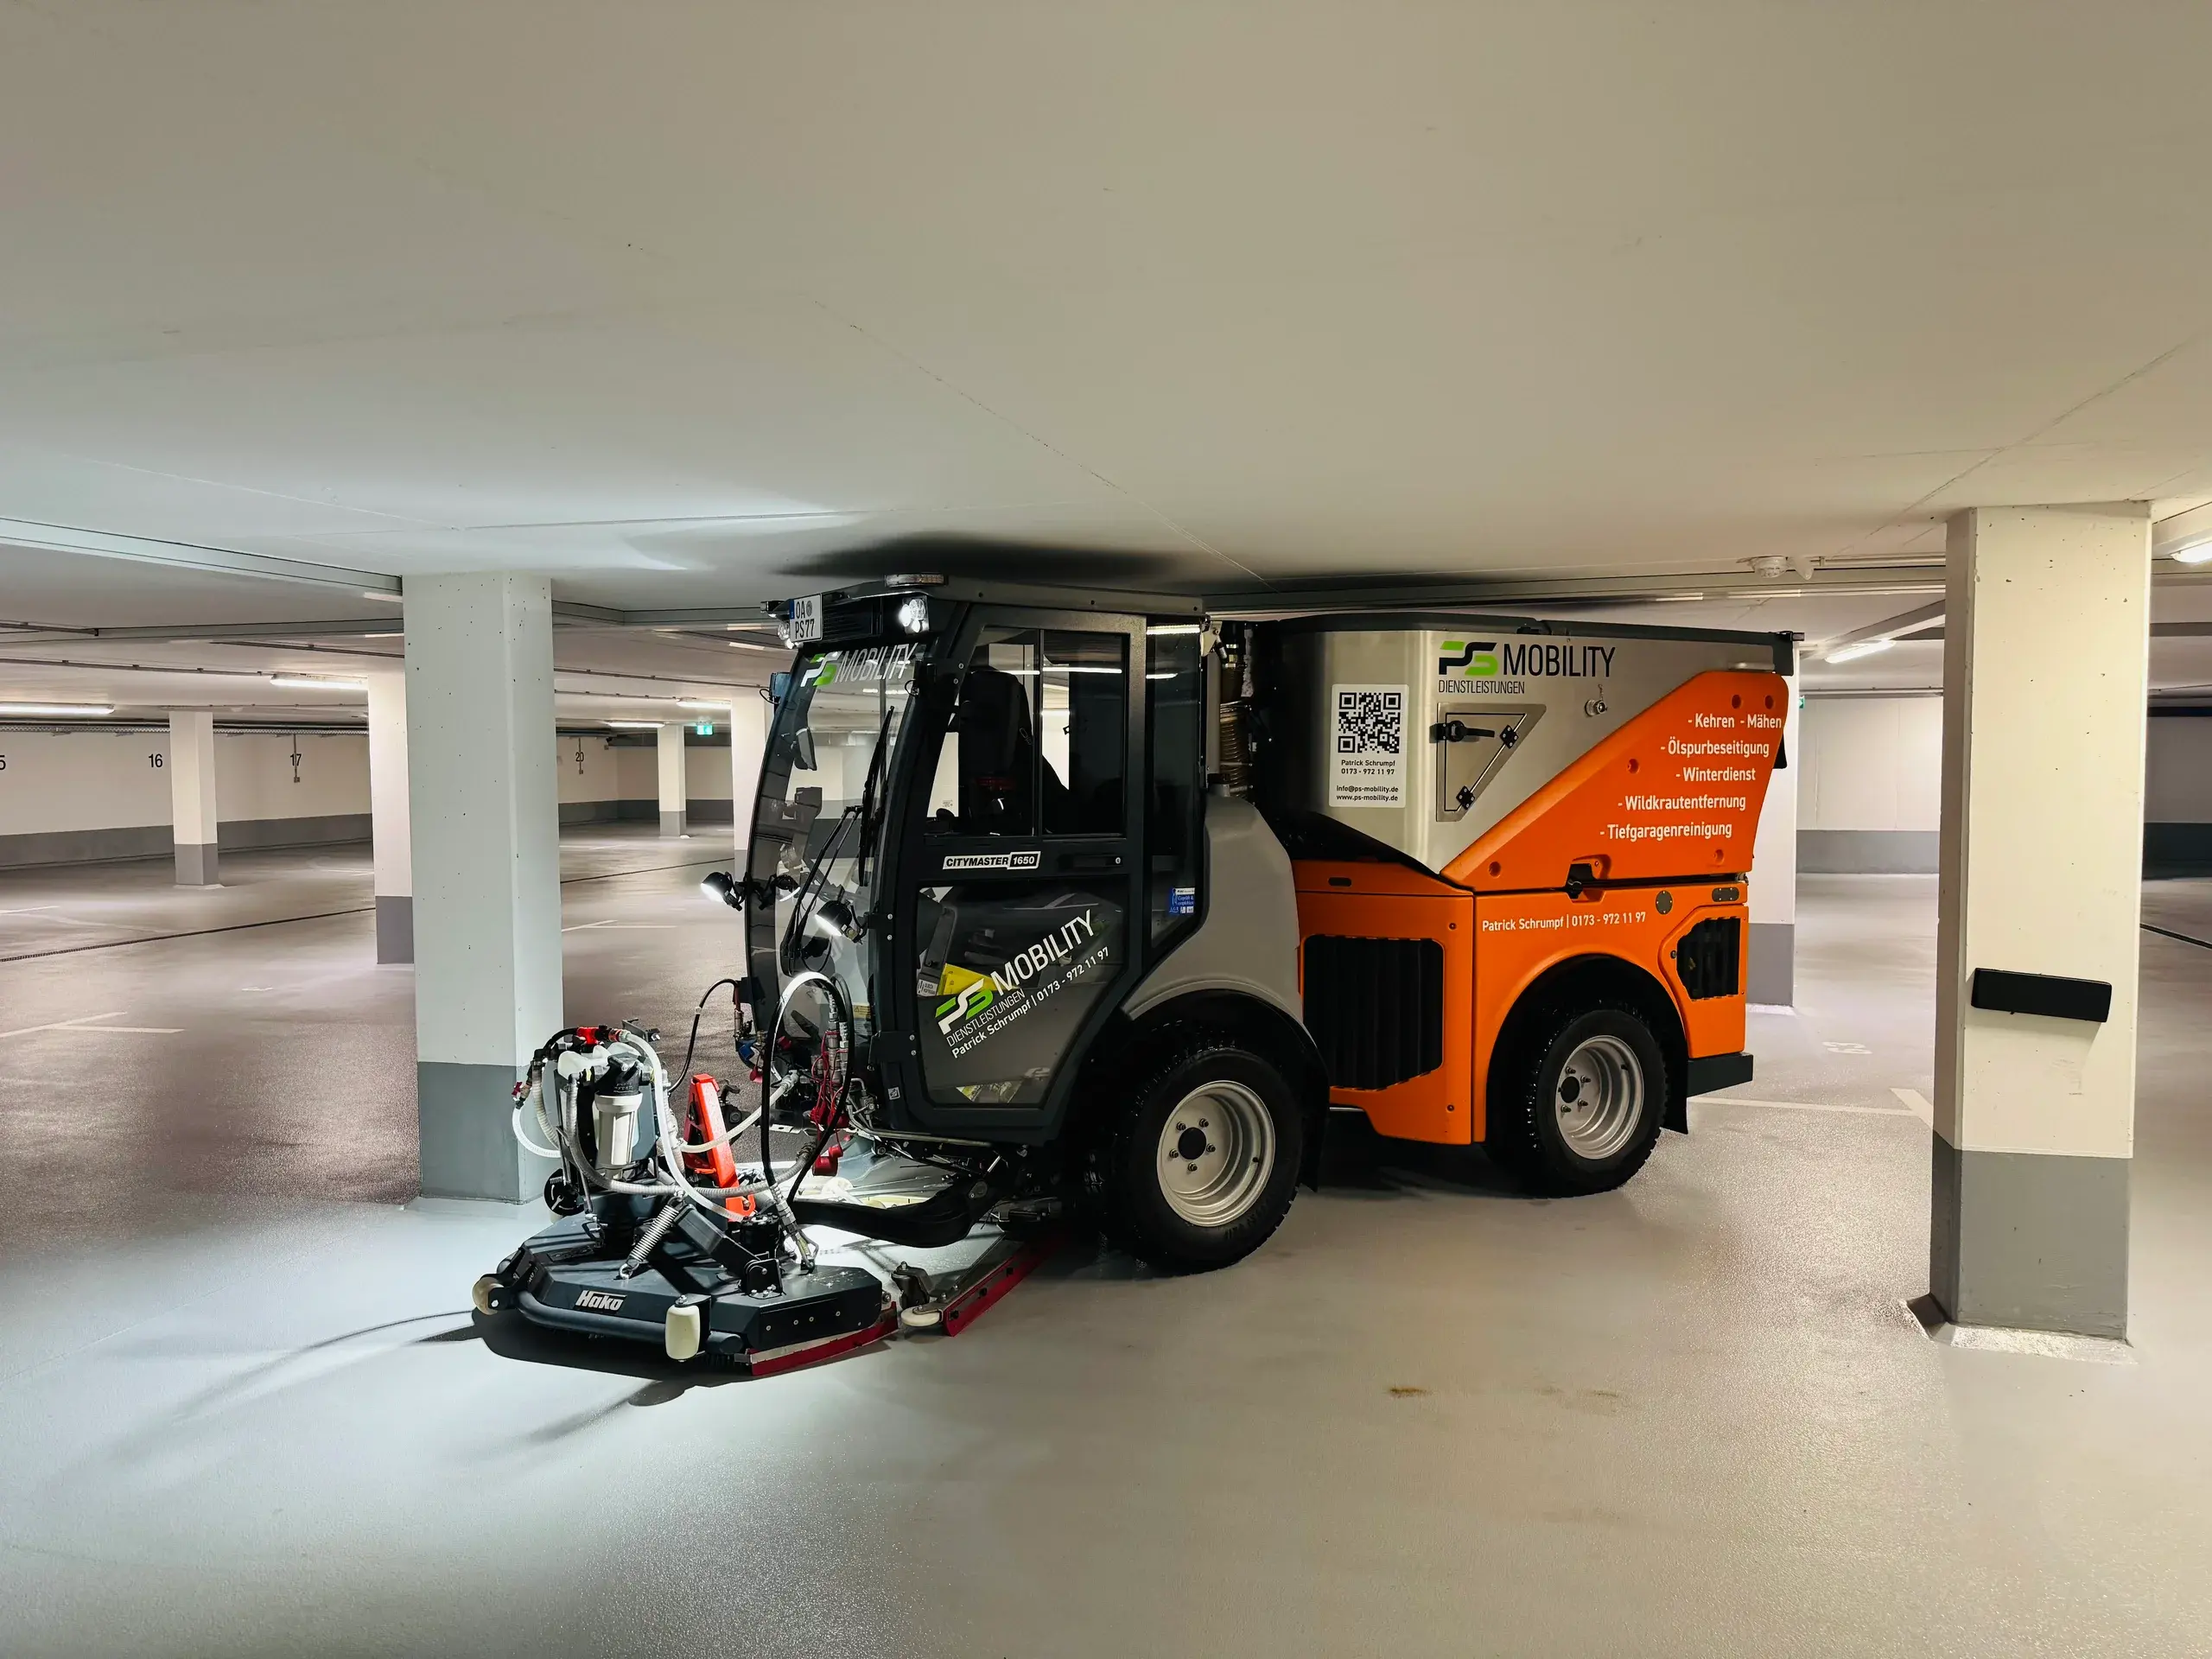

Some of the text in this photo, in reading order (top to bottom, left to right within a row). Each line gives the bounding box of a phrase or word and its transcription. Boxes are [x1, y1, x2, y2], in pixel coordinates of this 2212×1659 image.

[796, 601, 805, 619] OA
[835, 642, 918, 683] MOBILITY
[1503, 644, 1616, 677] MOBILITY
[1438, 679, 1525, 694] DIENSTLEISTUNGEN
[148, 753, 163, 768] 16
[289, 753, 302, 766] 17
[575, 752, 584, 762] 20
[946, 855, 1035, 867] CITYMASTER 1650
[1482, 918, 1516, 931] Patrick
[1518, 916, 1564, 930] Schrumpf
[1572, 914, 1595, 926] 0173
[1603, 913, 1620, 925] 972
[1623, 912, 1632, 924] 11
[1636, 912, 1646, 923] 97
[990, 909, 1094, 996] MOBILITY
[951, 1032, 987, 1059] Patrick
[988, 1000, 1032, 1035] Schrumpf
[1036, 980, 1060, 1001] 0173
[1066, 964, 1084, 982] 972
[1085, 957, 1096, 969] 11
[1097, 946, 1109, 962] 97
[946, 988, 1026, 1047] DIENSTLEISTUNGEN
[575, 1290, 628, 1311] Hako
